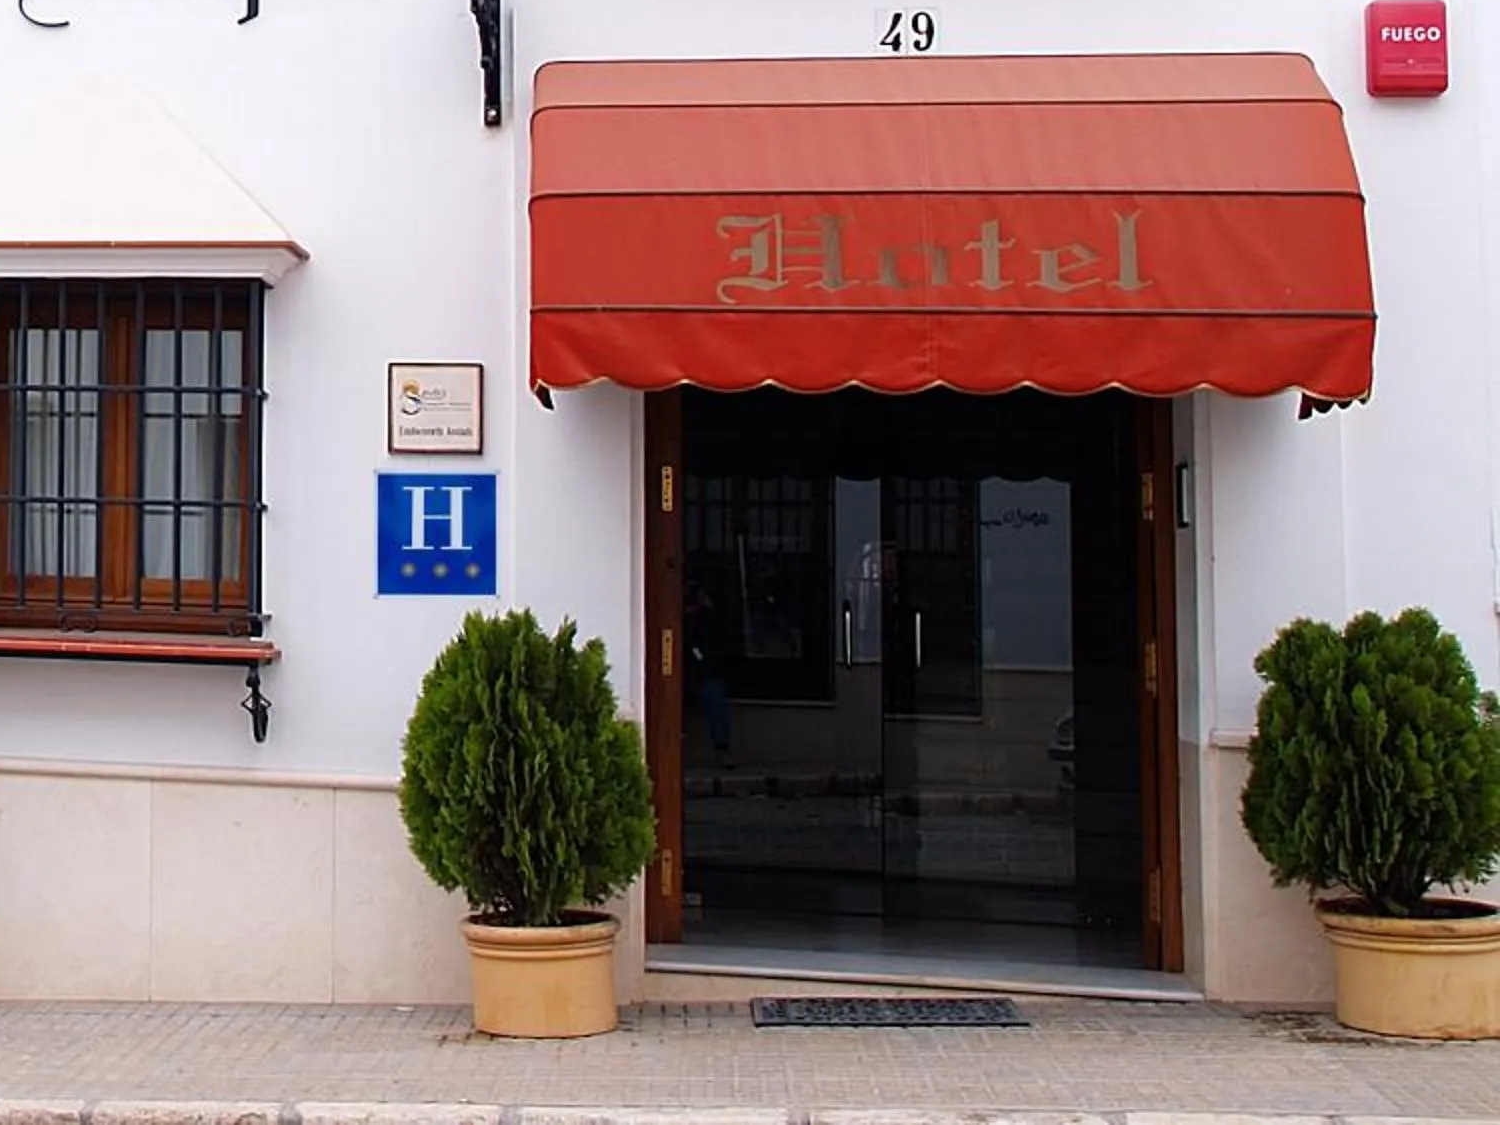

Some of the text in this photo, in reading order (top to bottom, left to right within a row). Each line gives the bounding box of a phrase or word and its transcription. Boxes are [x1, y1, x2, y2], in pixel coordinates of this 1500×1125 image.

[879, 11, 934, 52] 49
[1381, 26, 1441, 42] FUEGO
[716, 210, 1153, 303] Hotel
[402, 486, 473, 550] H
